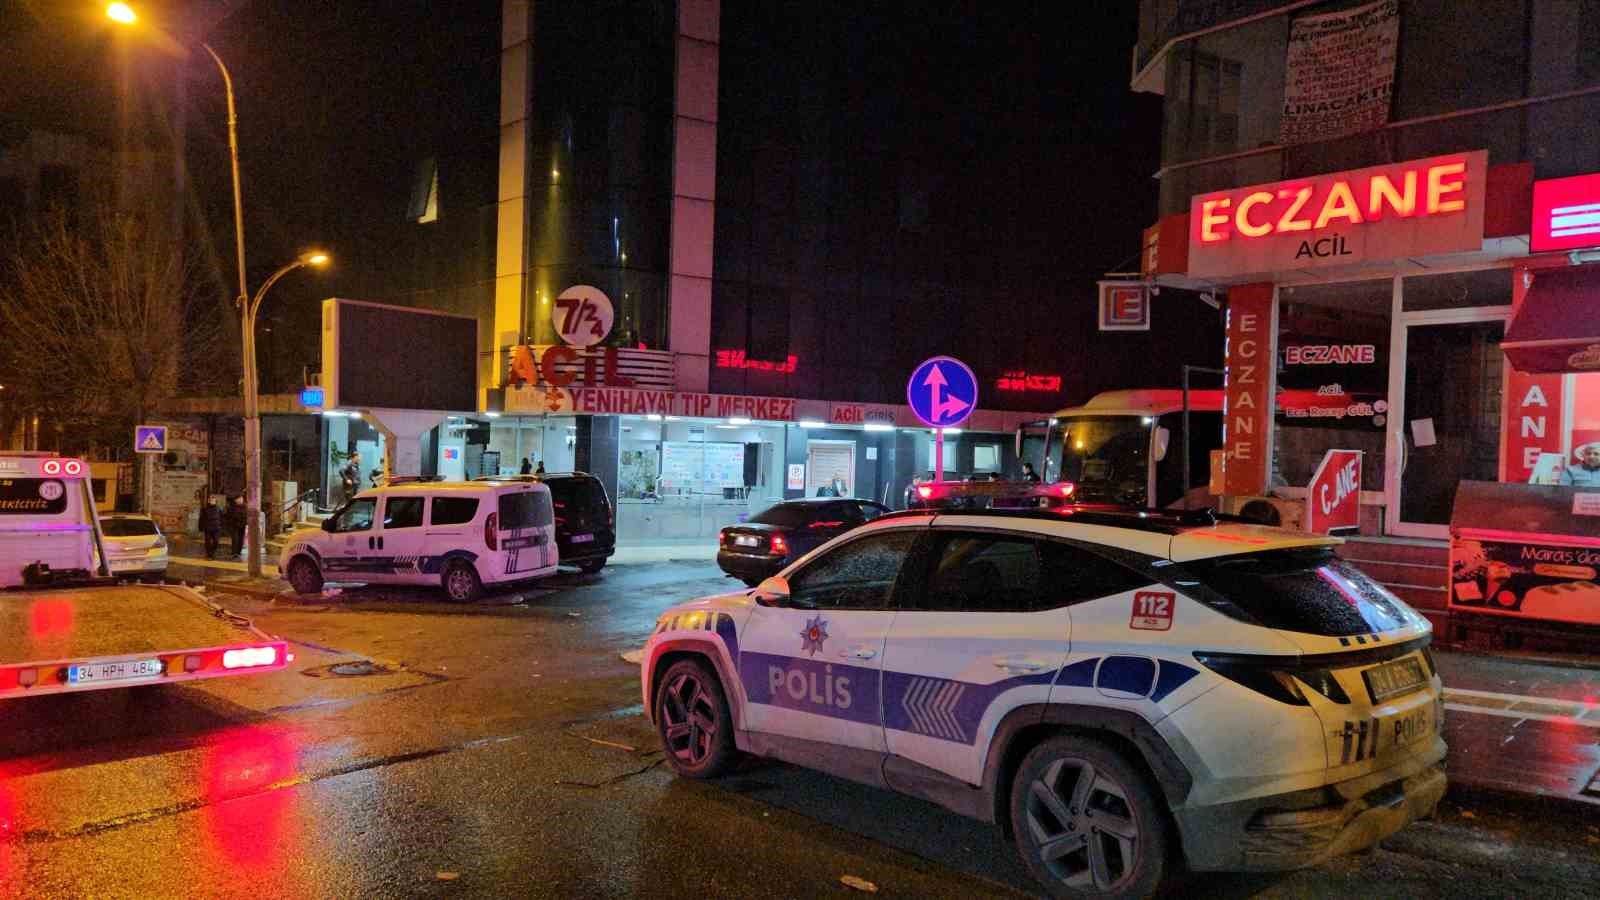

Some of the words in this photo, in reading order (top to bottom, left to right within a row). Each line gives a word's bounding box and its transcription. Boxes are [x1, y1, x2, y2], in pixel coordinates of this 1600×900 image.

[1201, 163, 1465, 242] ECZANE
[1295, 233, 1353, 259] ACİL
[510, 344, 637, 387] ACİL
[1285, 344, 1376, 364] ECZANE
[1232, 314, 1257, 460] ECZANE
[568, 388, 675, 414] YENİHAYAT
[681, 394, 711, 415] TIP
[718, 397, 795, 420] MERKEZİ
[834, 406, 864, 422] ACİL
[1139, 596, 1169, 616] 112
[80, 667, 93, 679] 34
[769, 664, 852, 709] POLİS
